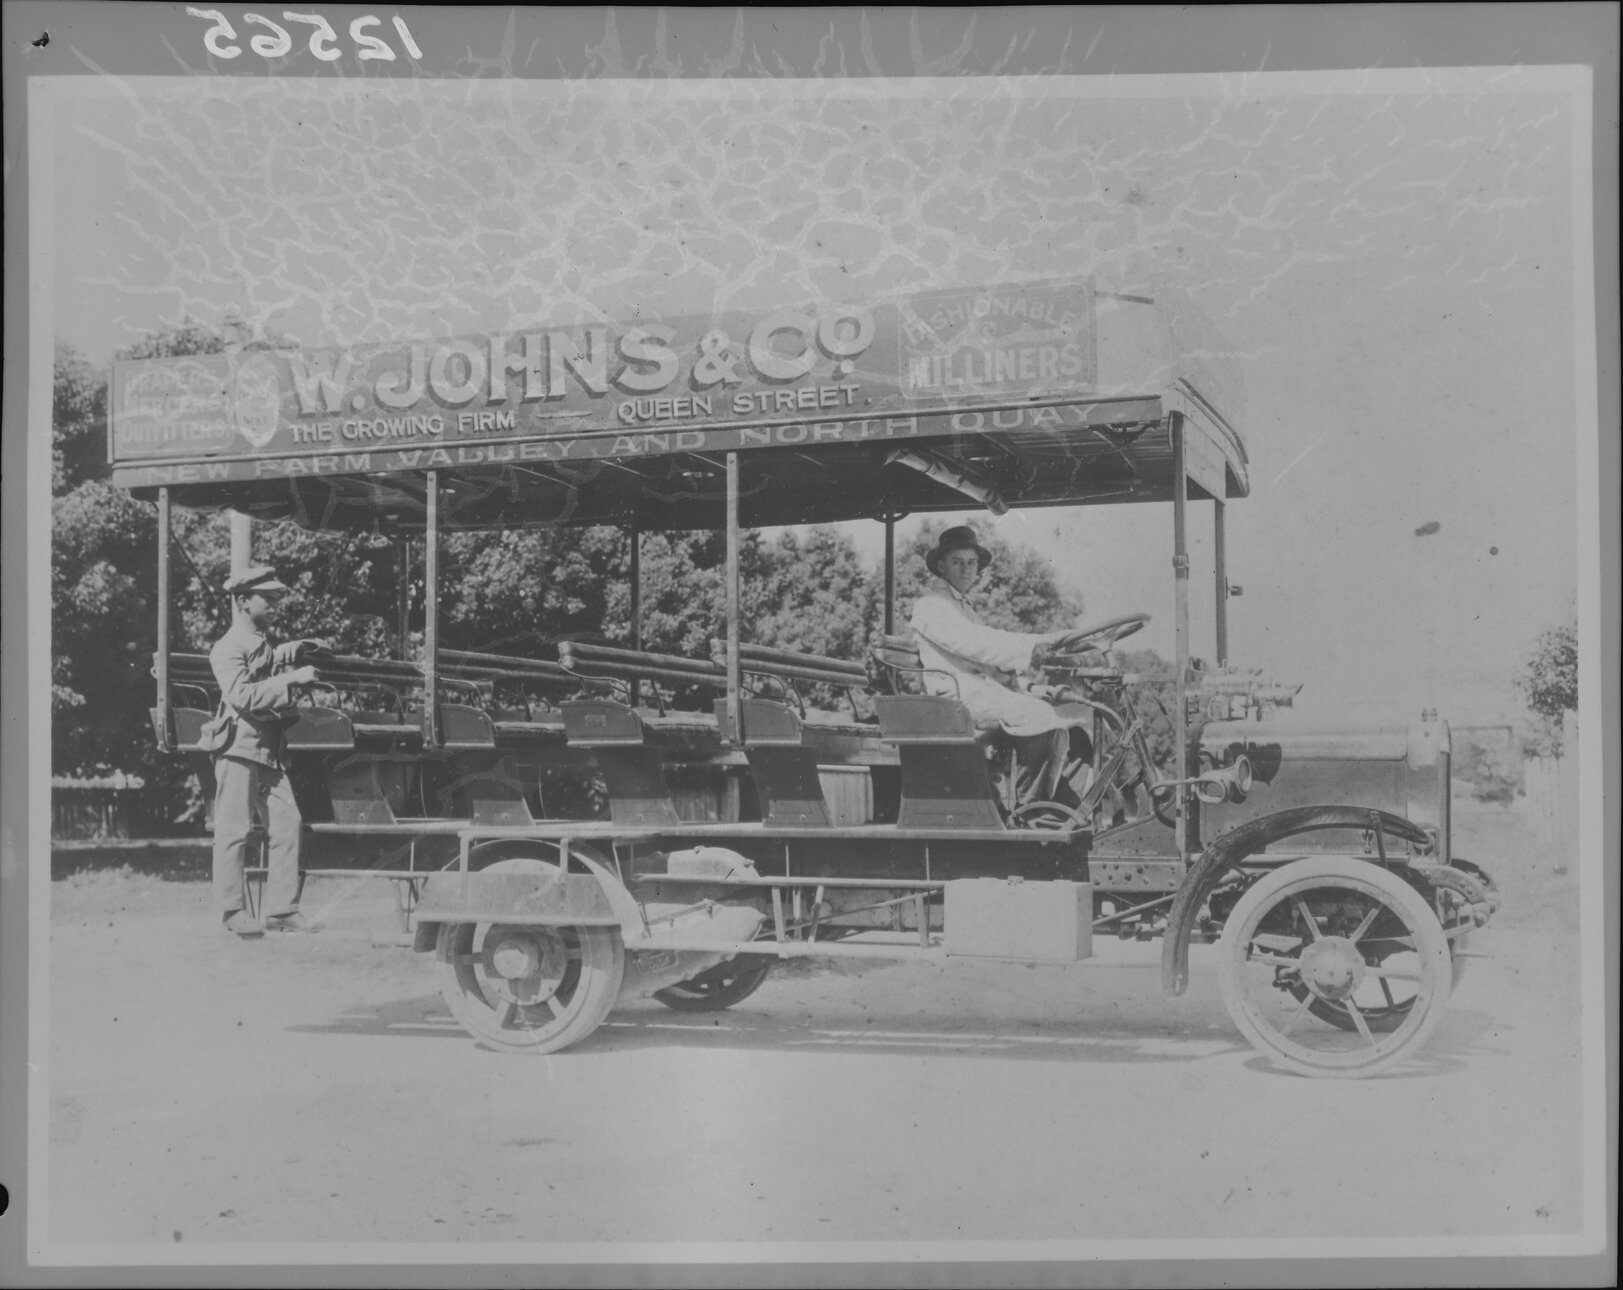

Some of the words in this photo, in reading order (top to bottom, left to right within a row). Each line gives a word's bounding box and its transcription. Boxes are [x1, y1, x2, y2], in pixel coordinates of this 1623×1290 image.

[374, 324, 680, 408] JOHNS
[693, 328, 744, 385] &
[908, 343, 1083, 389] MILLINERS
[288, 422, 332, 443] THE
[342, 415, 444, 439] GROWING
[458, 411, 516, 432] FIRM
[617, 396, 712, 424] QUEEN
[147, 463, 230, 484] NEW
[398, 440, 577, 468] VALLEY
[611, 431, 706, 454] AND
[741, 416, 918, 446] NORTH
[951, 403, 1098, 432] QUAY
